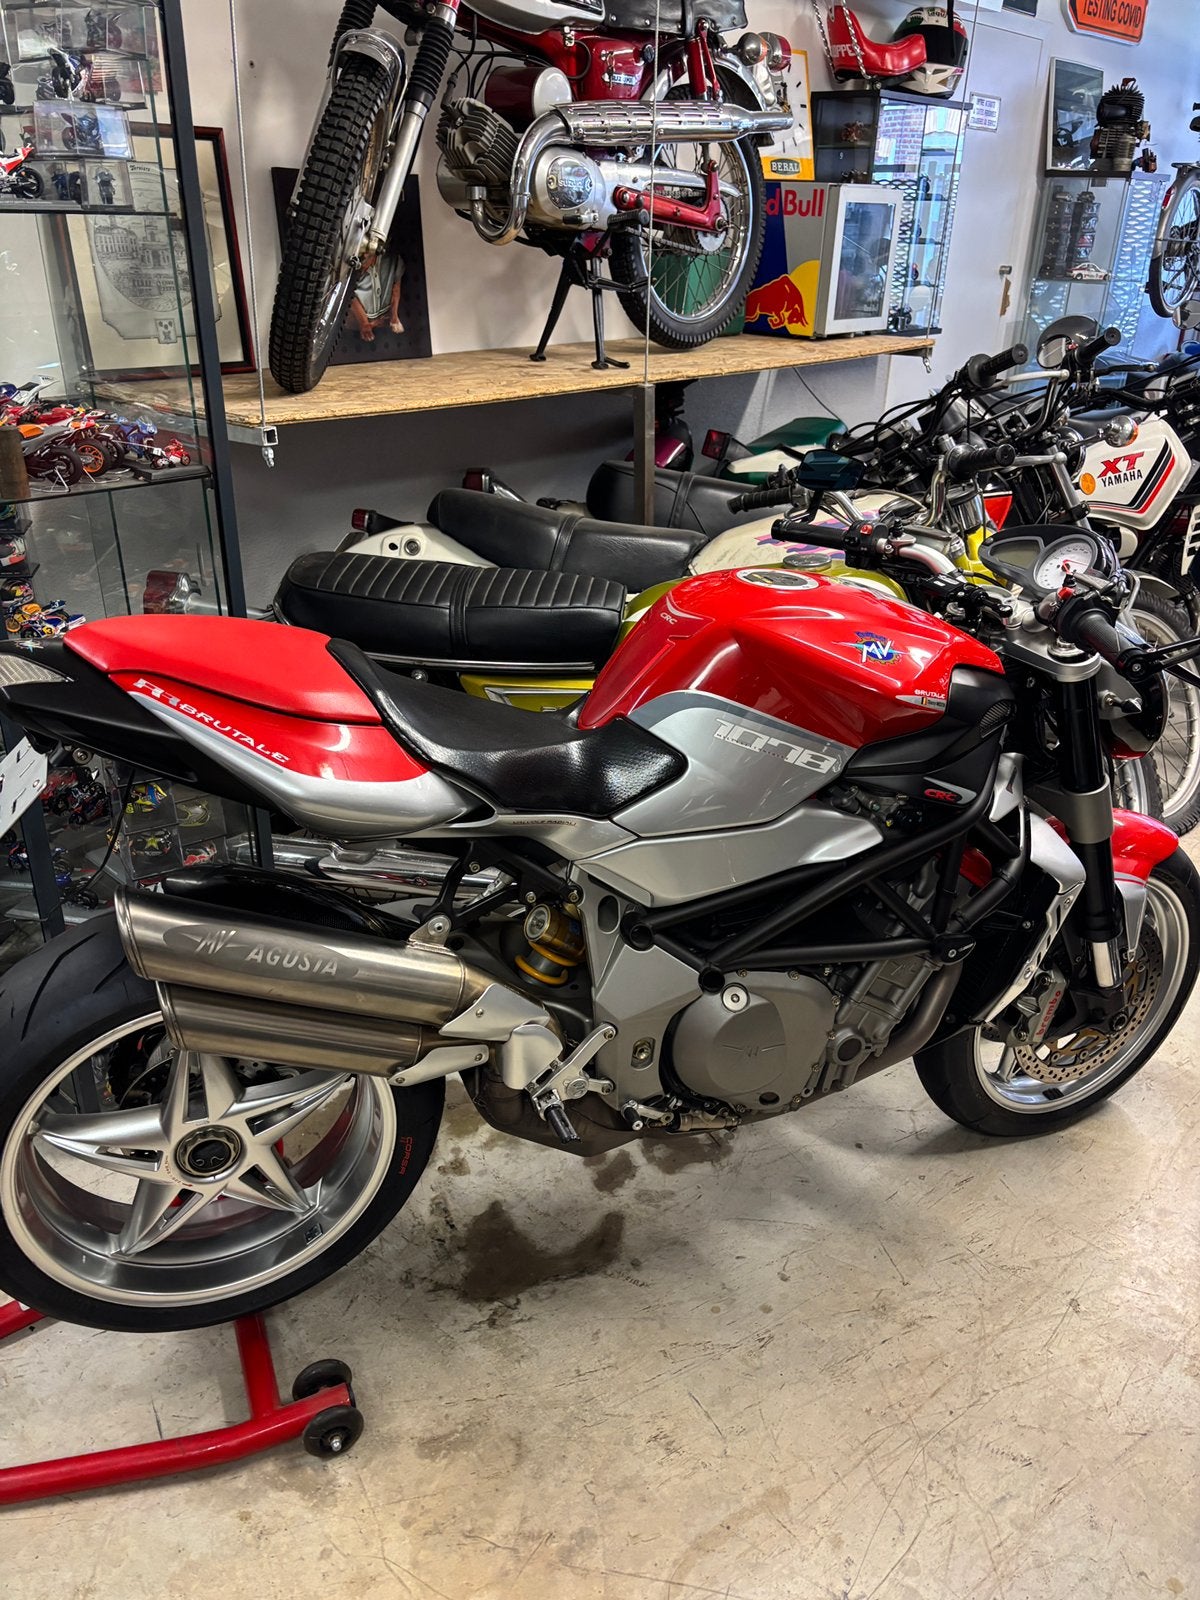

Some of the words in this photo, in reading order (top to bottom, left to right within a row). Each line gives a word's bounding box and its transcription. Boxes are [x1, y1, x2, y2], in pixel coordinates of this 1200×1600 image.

[1083, 0, 1118, 22] TESTING
[1117, 2, 1142, 29] COVID
[771, 161, 800, 172] BERAL
[783, 188, 825, 217] Bull
[1097, 451, 1145, 479] XT
[1101, 469, 1143, 488] YAMAHA
[660, 612, 678, 625] CRC
[914, 688, 946, 699] BRUTALE
[179, 703, 291, 763] BRUTALE
[713, 718, 838, 774] 1078
[924, 788, 958, 803] CRC
[245, 943, 338, 977] AGUSTA
[1035, 990, 1062, 1036] brembo
